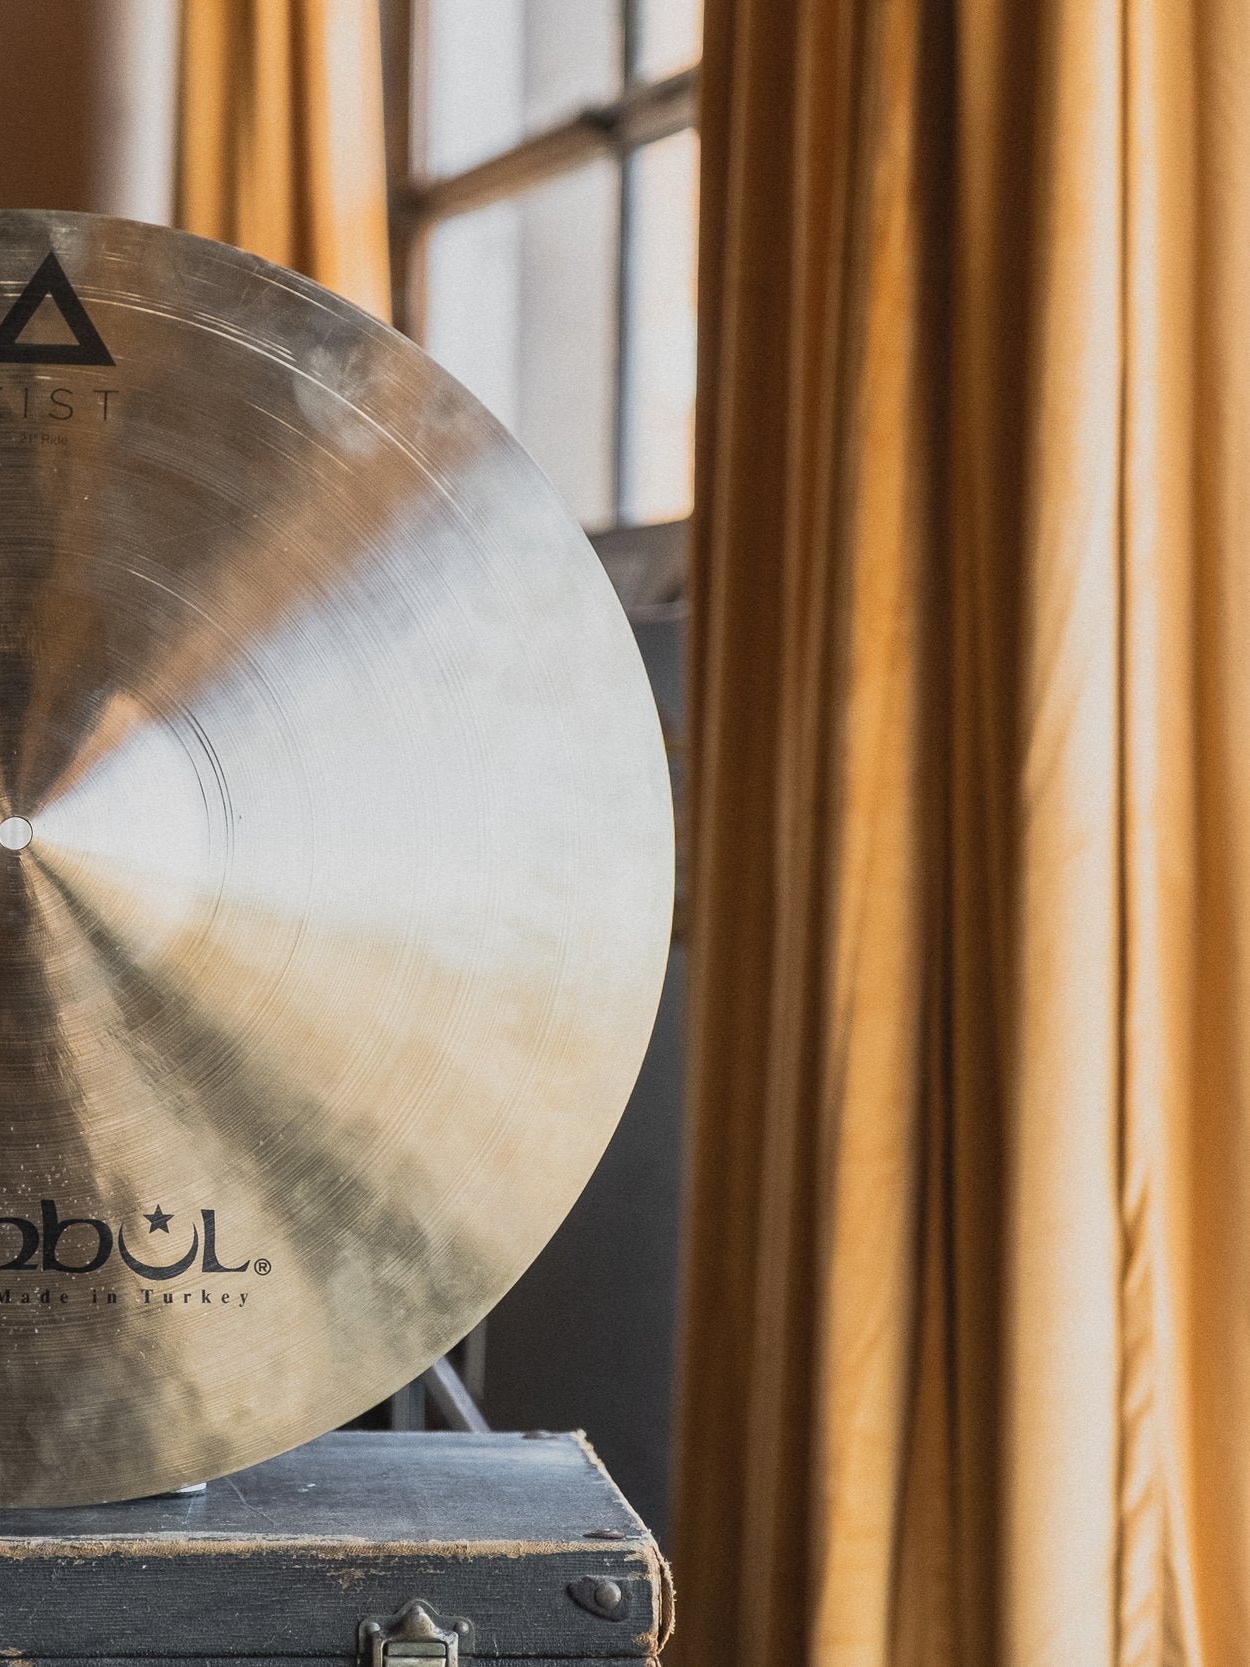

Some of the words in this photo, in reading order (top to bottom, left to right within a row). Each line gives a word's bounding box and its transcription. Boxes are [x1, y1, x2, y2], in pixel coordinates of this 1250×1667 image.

[41, 433, 69, 446] Ride
[92, 1288, 117, 1304] in
[141, 1288, 249, 1308] Turkey
